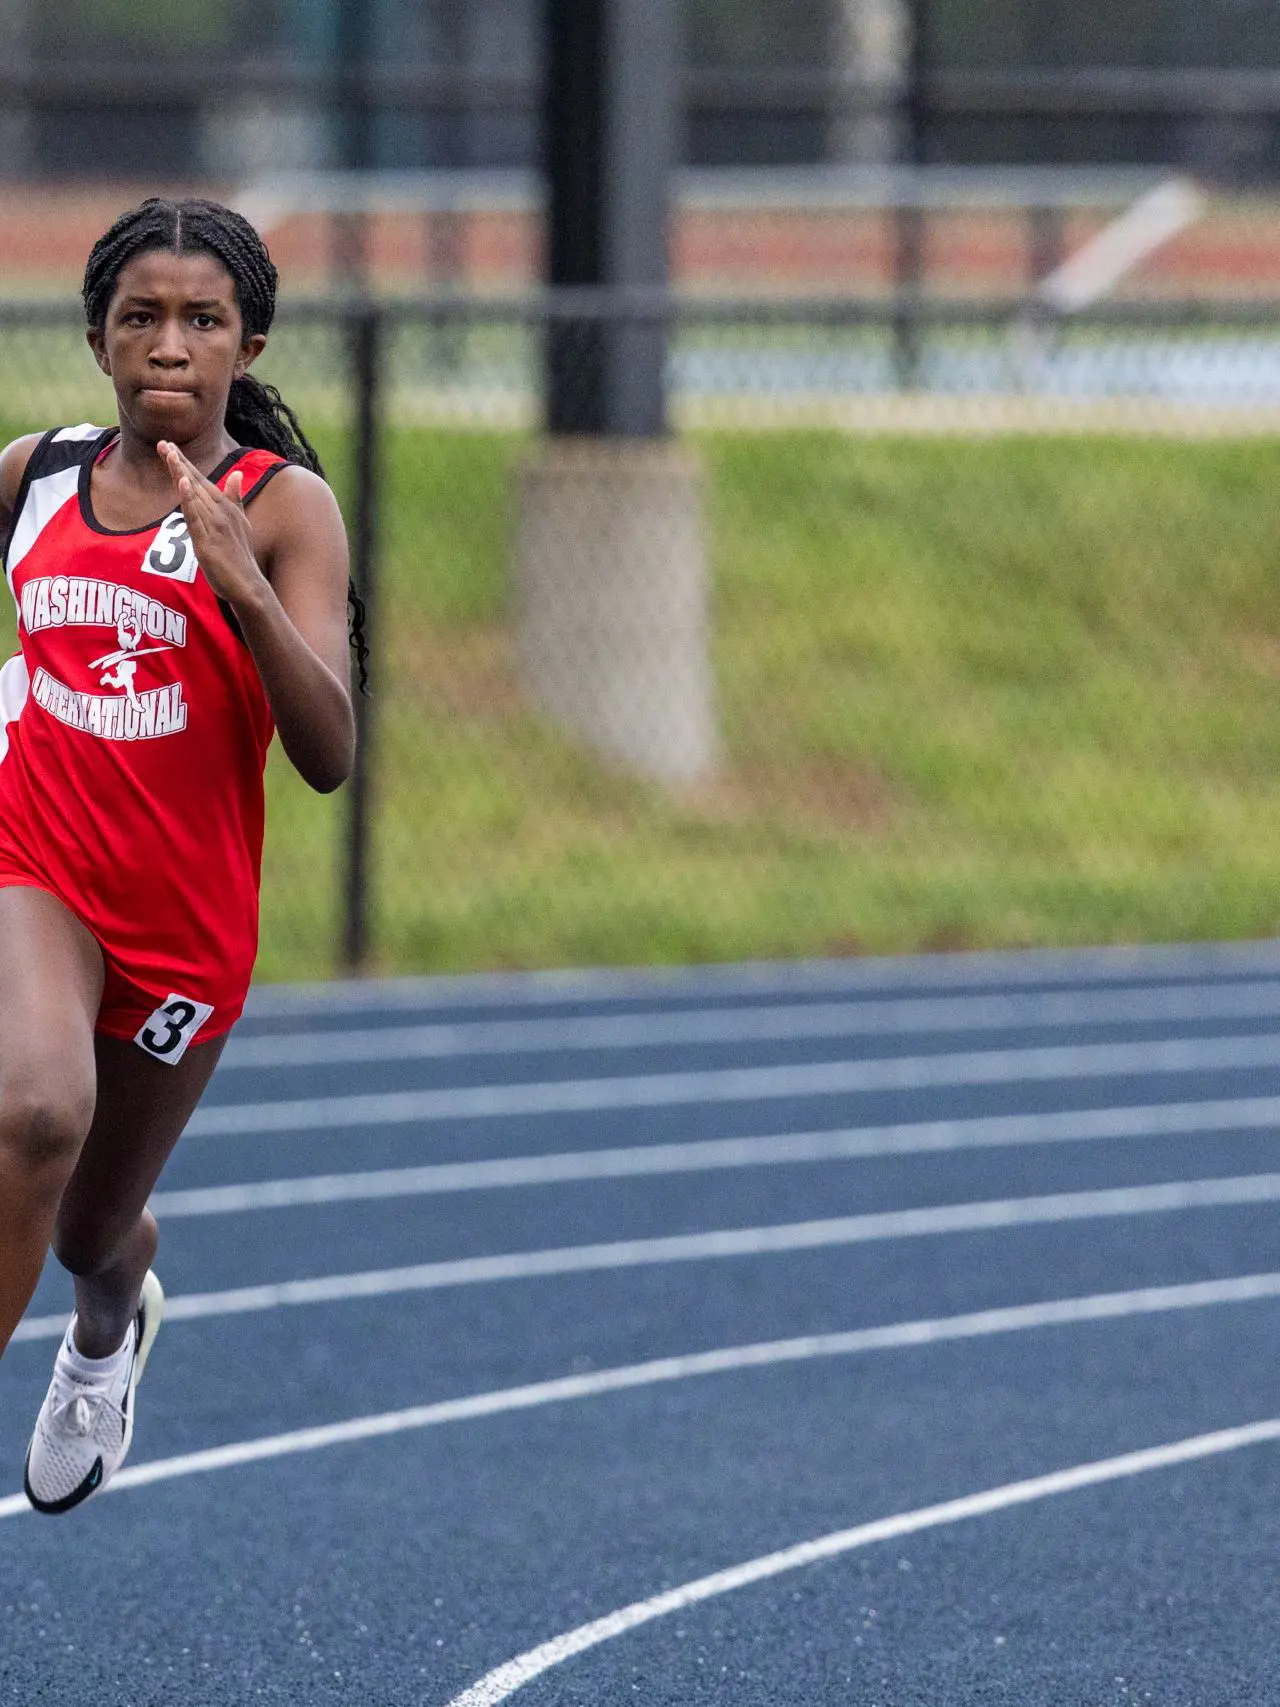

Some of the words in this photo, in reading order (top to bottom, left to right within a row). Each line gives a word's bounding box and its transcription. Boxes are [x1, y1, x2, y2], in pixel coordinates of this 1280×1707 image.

[149, 518, 190, 573] 3
[21, 576, 187, 648] WASHINGTON
[32, 667, 188, 741] INTERNATIONAL
[141, 1001, 196, 1054] 3
